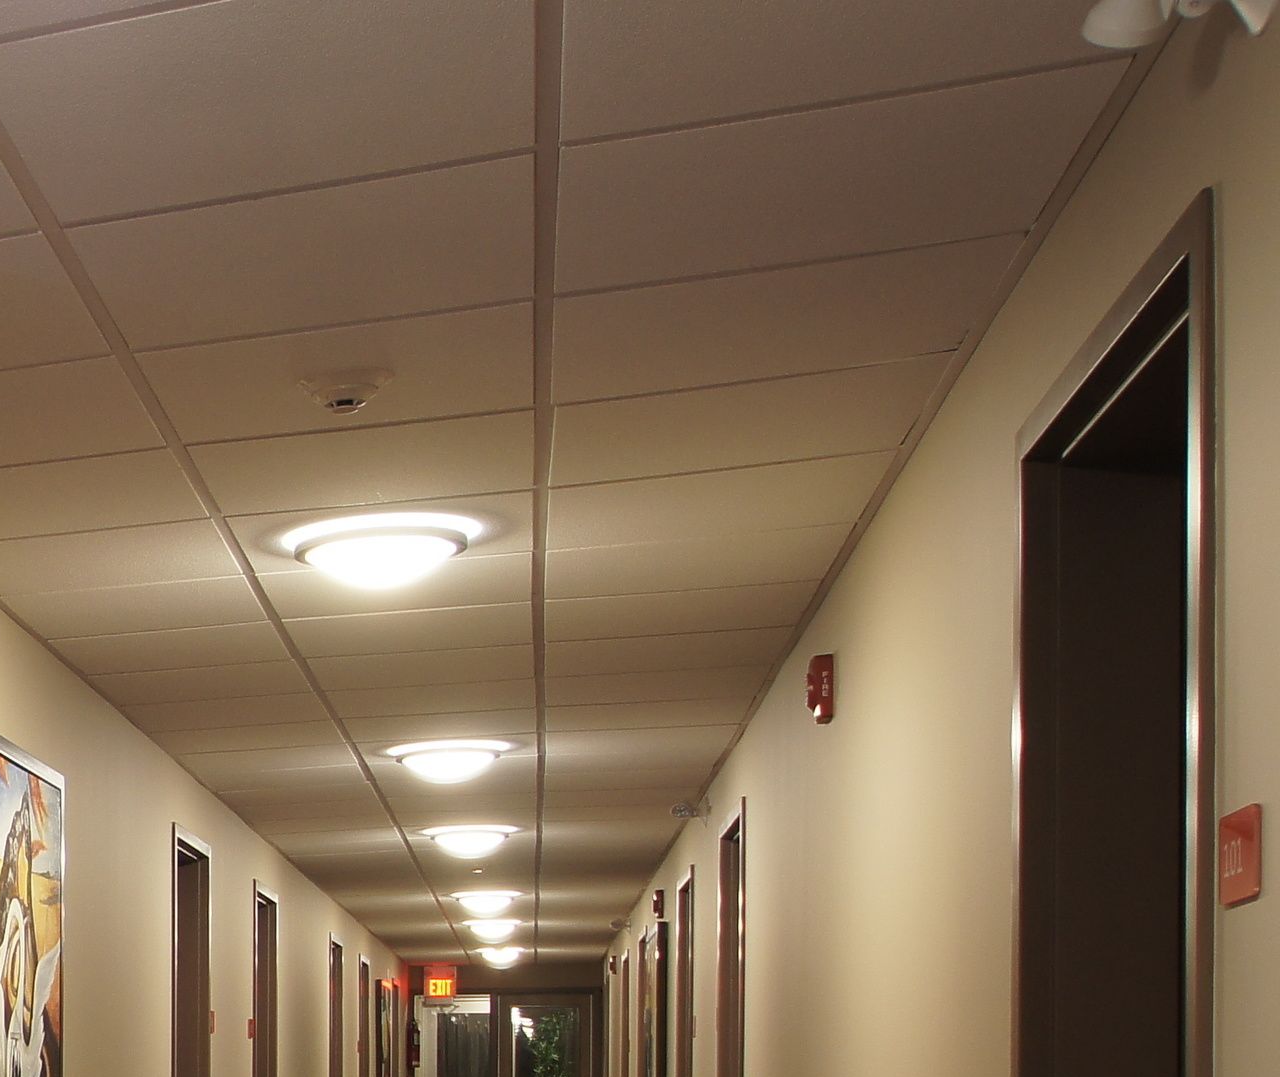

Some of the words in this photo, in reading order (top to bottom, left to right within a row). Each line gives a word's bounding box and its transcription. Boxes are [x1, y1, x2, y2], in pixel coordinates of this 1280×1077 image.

[821, 670, 829, 698] FIRE
[1223, 837, 1243, 878] 101
[429, 979, 452, 996] EXIT
